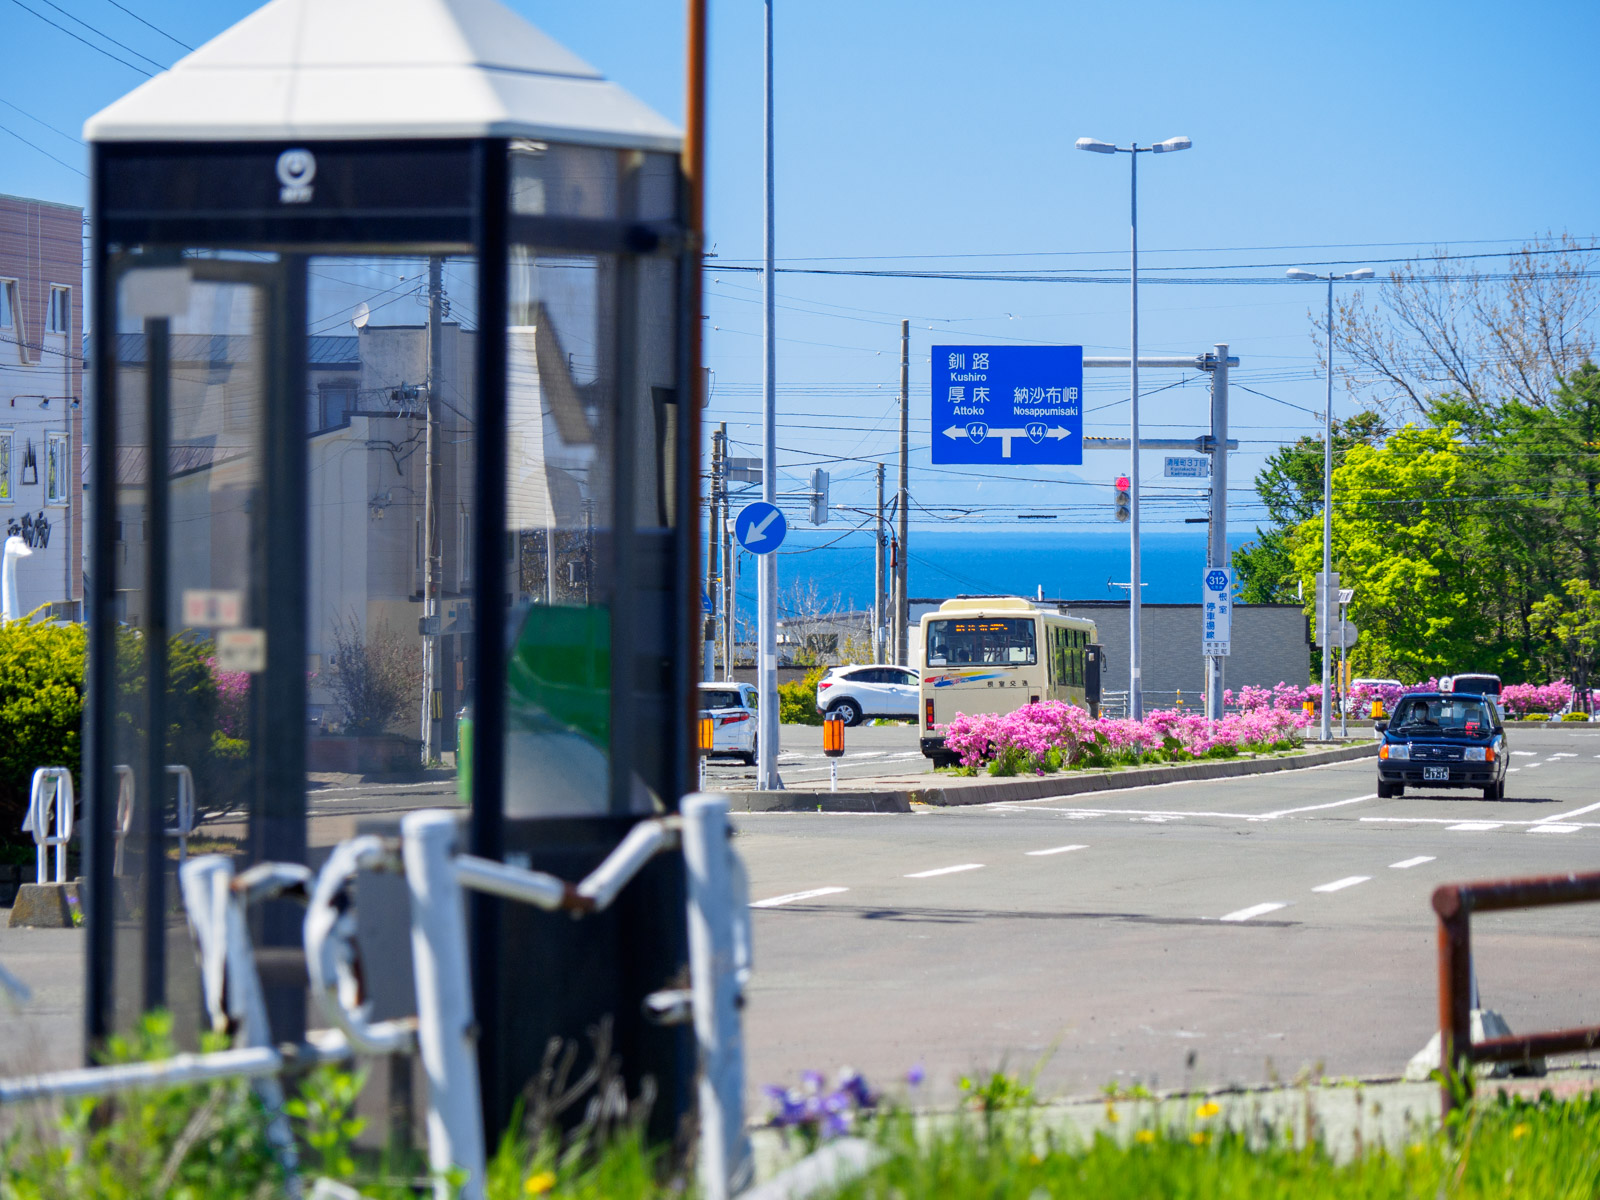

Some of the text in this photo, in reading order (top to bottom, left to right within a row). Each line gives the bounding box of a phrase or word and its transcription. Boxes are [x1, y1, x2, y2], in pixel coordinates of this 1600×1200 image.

[948, 352, 990, 370] 釧路
[950, 372, 987, 382] Kushiro
[947, 386, 990, 404] 厚床
[1013, 386, 1079, 404] 納沙布岬
[953, 406, 985, 415] Attoko
[1013, 406, 1078, 417] Nosappumisaki
[970, 426, 983, 437] 44
[1030, 426, 1043, 437] 44
[1209, 576, 1225, 585] 312
